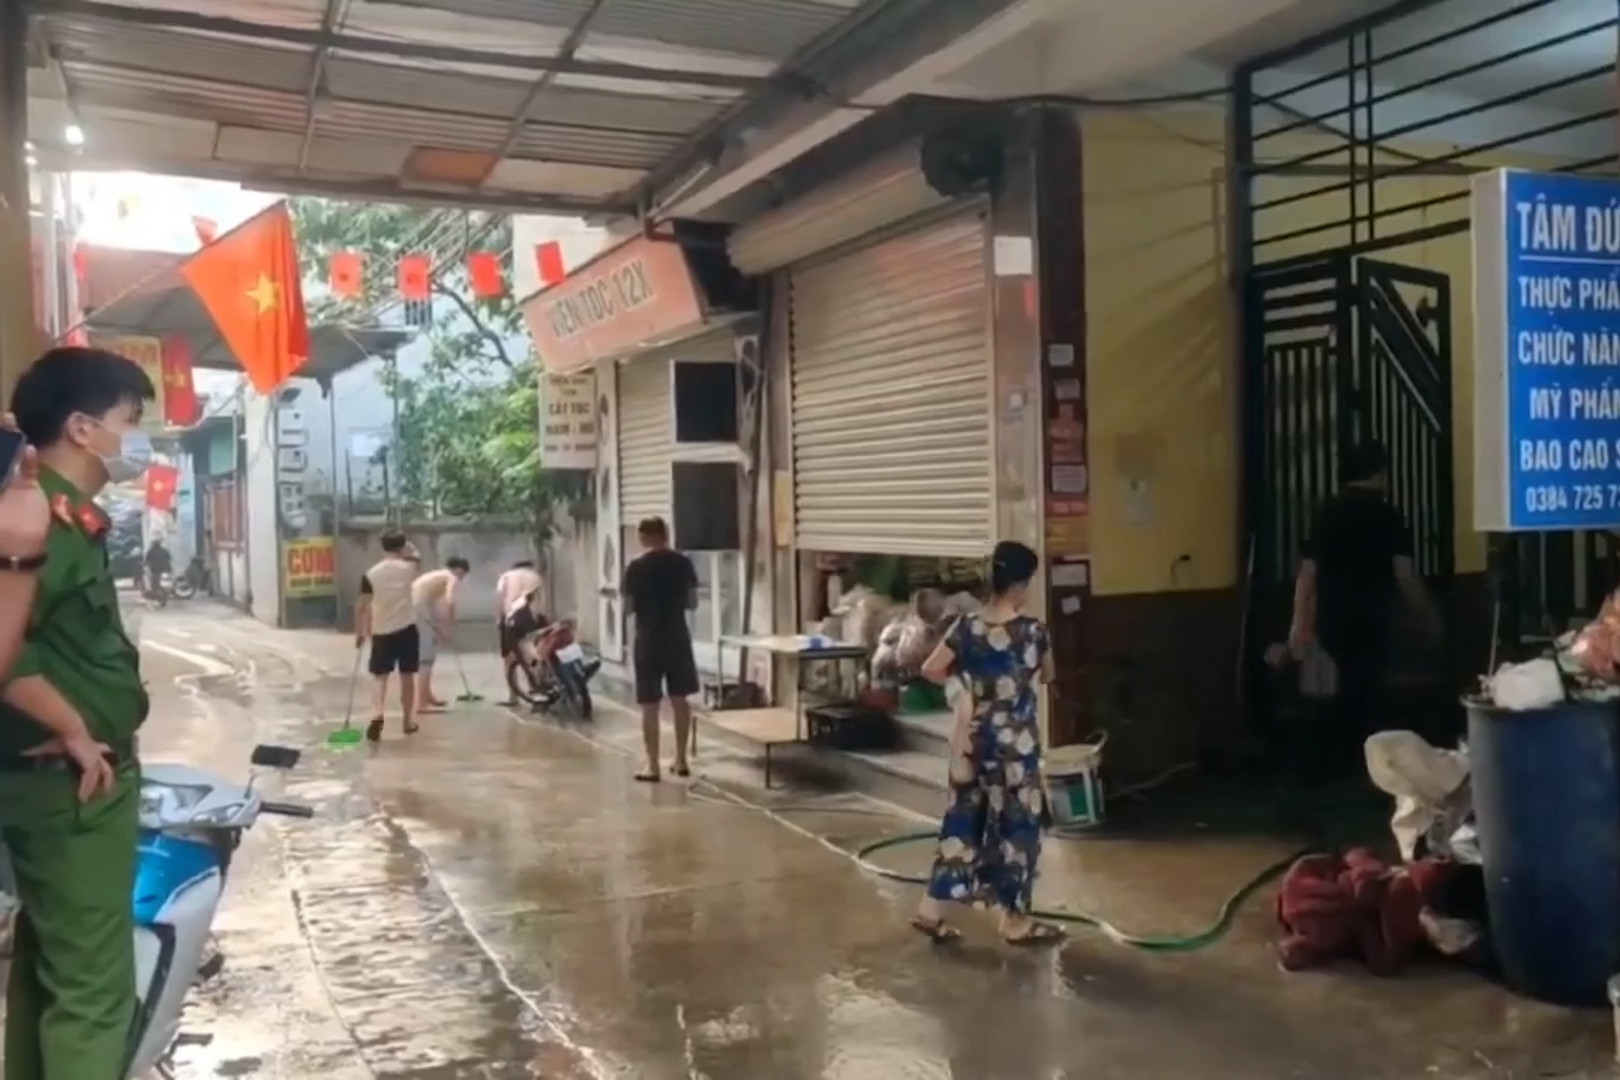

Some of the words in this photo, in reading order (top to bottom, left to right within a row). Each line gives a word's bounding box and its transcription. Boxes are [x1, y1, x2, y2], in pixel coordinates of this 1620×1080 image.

[1515, 191, 1576, 252] TÂM
[1517, 274, 1572, 316] THỰC
[1517, 323, 1576, 366] CHỨC
[1529, 382, 1563, 420] MỸ
[1519, 439, 1562, 472] BAO
[1568, 438, 1609, 471] CAO
[1525, 485, 1568, 512] 0384
[1573, 484, 1604, 510] 725
[1607, 484, 1620, 509] 7
